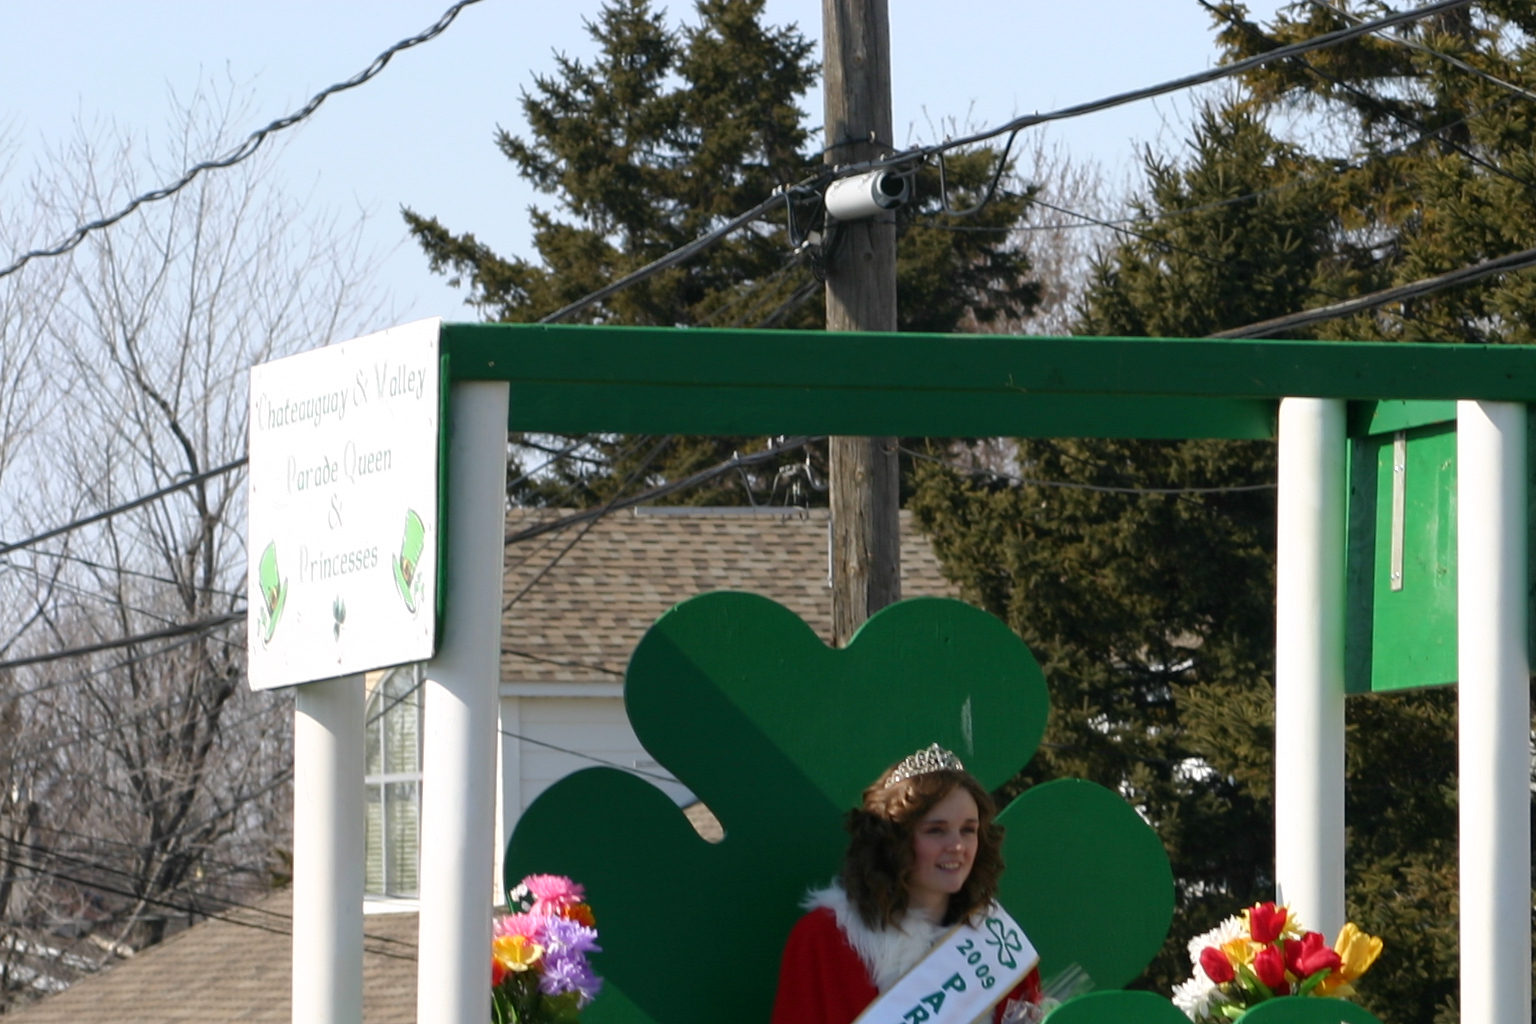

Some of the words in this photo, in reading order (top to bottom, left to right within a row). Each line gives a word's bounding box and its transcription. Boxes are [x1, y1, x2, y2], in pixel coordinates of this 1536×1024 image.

[255, 387, 348, 431] Chateauguay
[353, 368, 368, 407] &
[374, 358, 427, 401] Valley
[286, 454, 339, 495] Parade
[343, 439, 392, 485] Queen
[328, 492, 343, 530] &
[298, 543, 379, 583] Princesses
[956, 938, 996, 990] 2009
